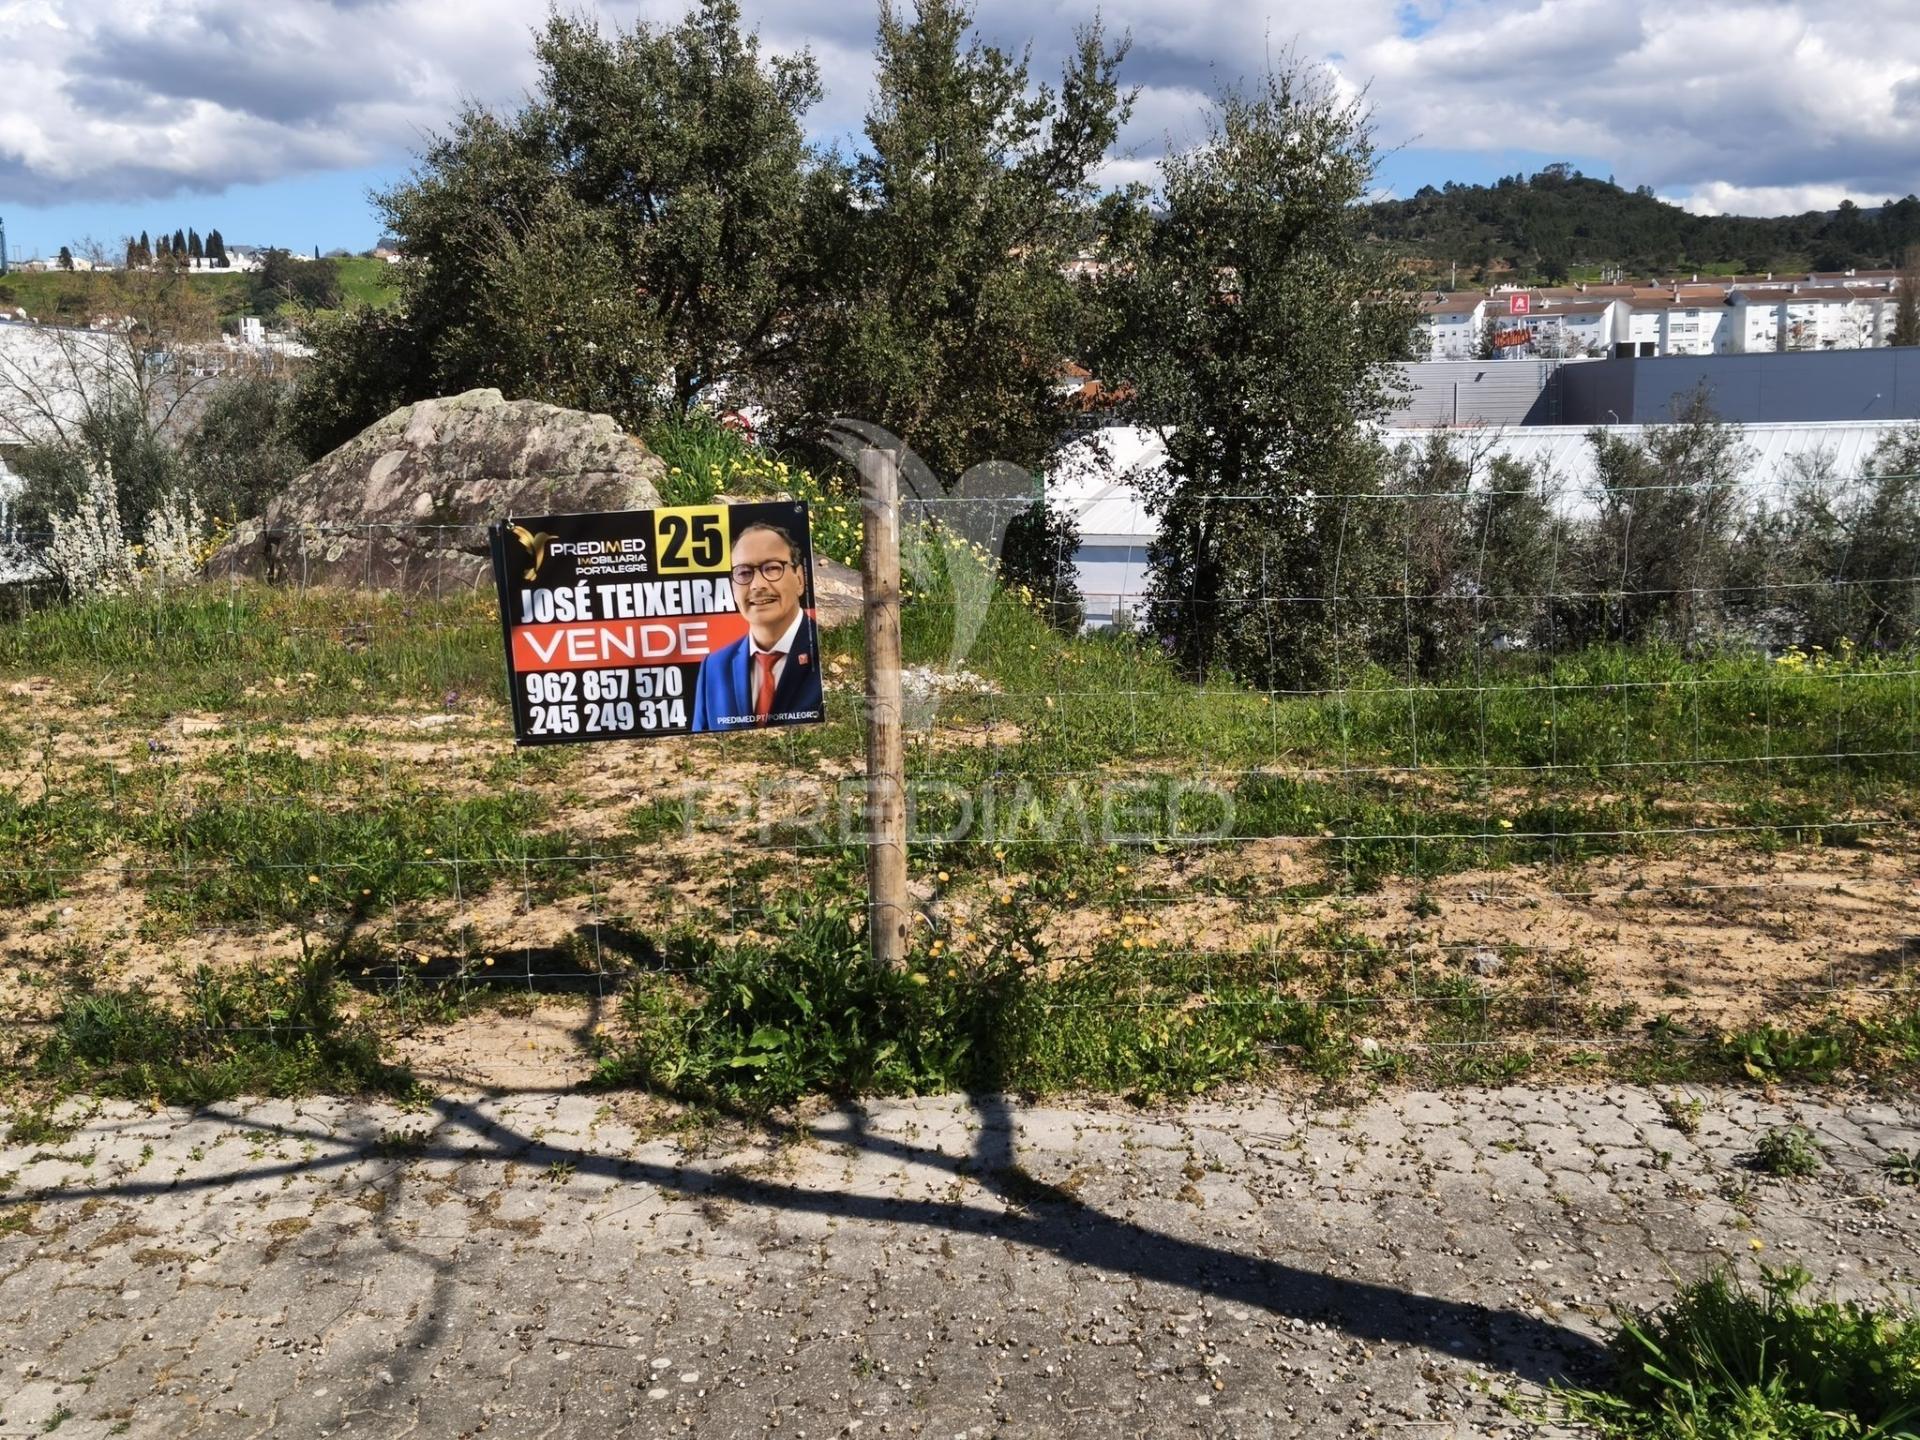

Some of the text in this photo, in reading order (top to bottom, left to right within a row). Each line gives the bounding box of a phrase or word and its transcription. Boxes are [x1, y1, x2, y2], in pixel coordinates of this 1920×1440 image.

[550, 538, 646, 556] PREDIMED
[658, 514, 723, 568] 25
[575, 563, 648, 575] PORTALEGRE
[577, 554, 647, 566] IMOBILIARIA
[521, 577, 737, 623] JOSÉ TEIXEIRA
[522, 621, 711, 663] VENDE
[525, 666, 683, 703] 962 857 570
[529, 698, 687, 735] 245 249 314
